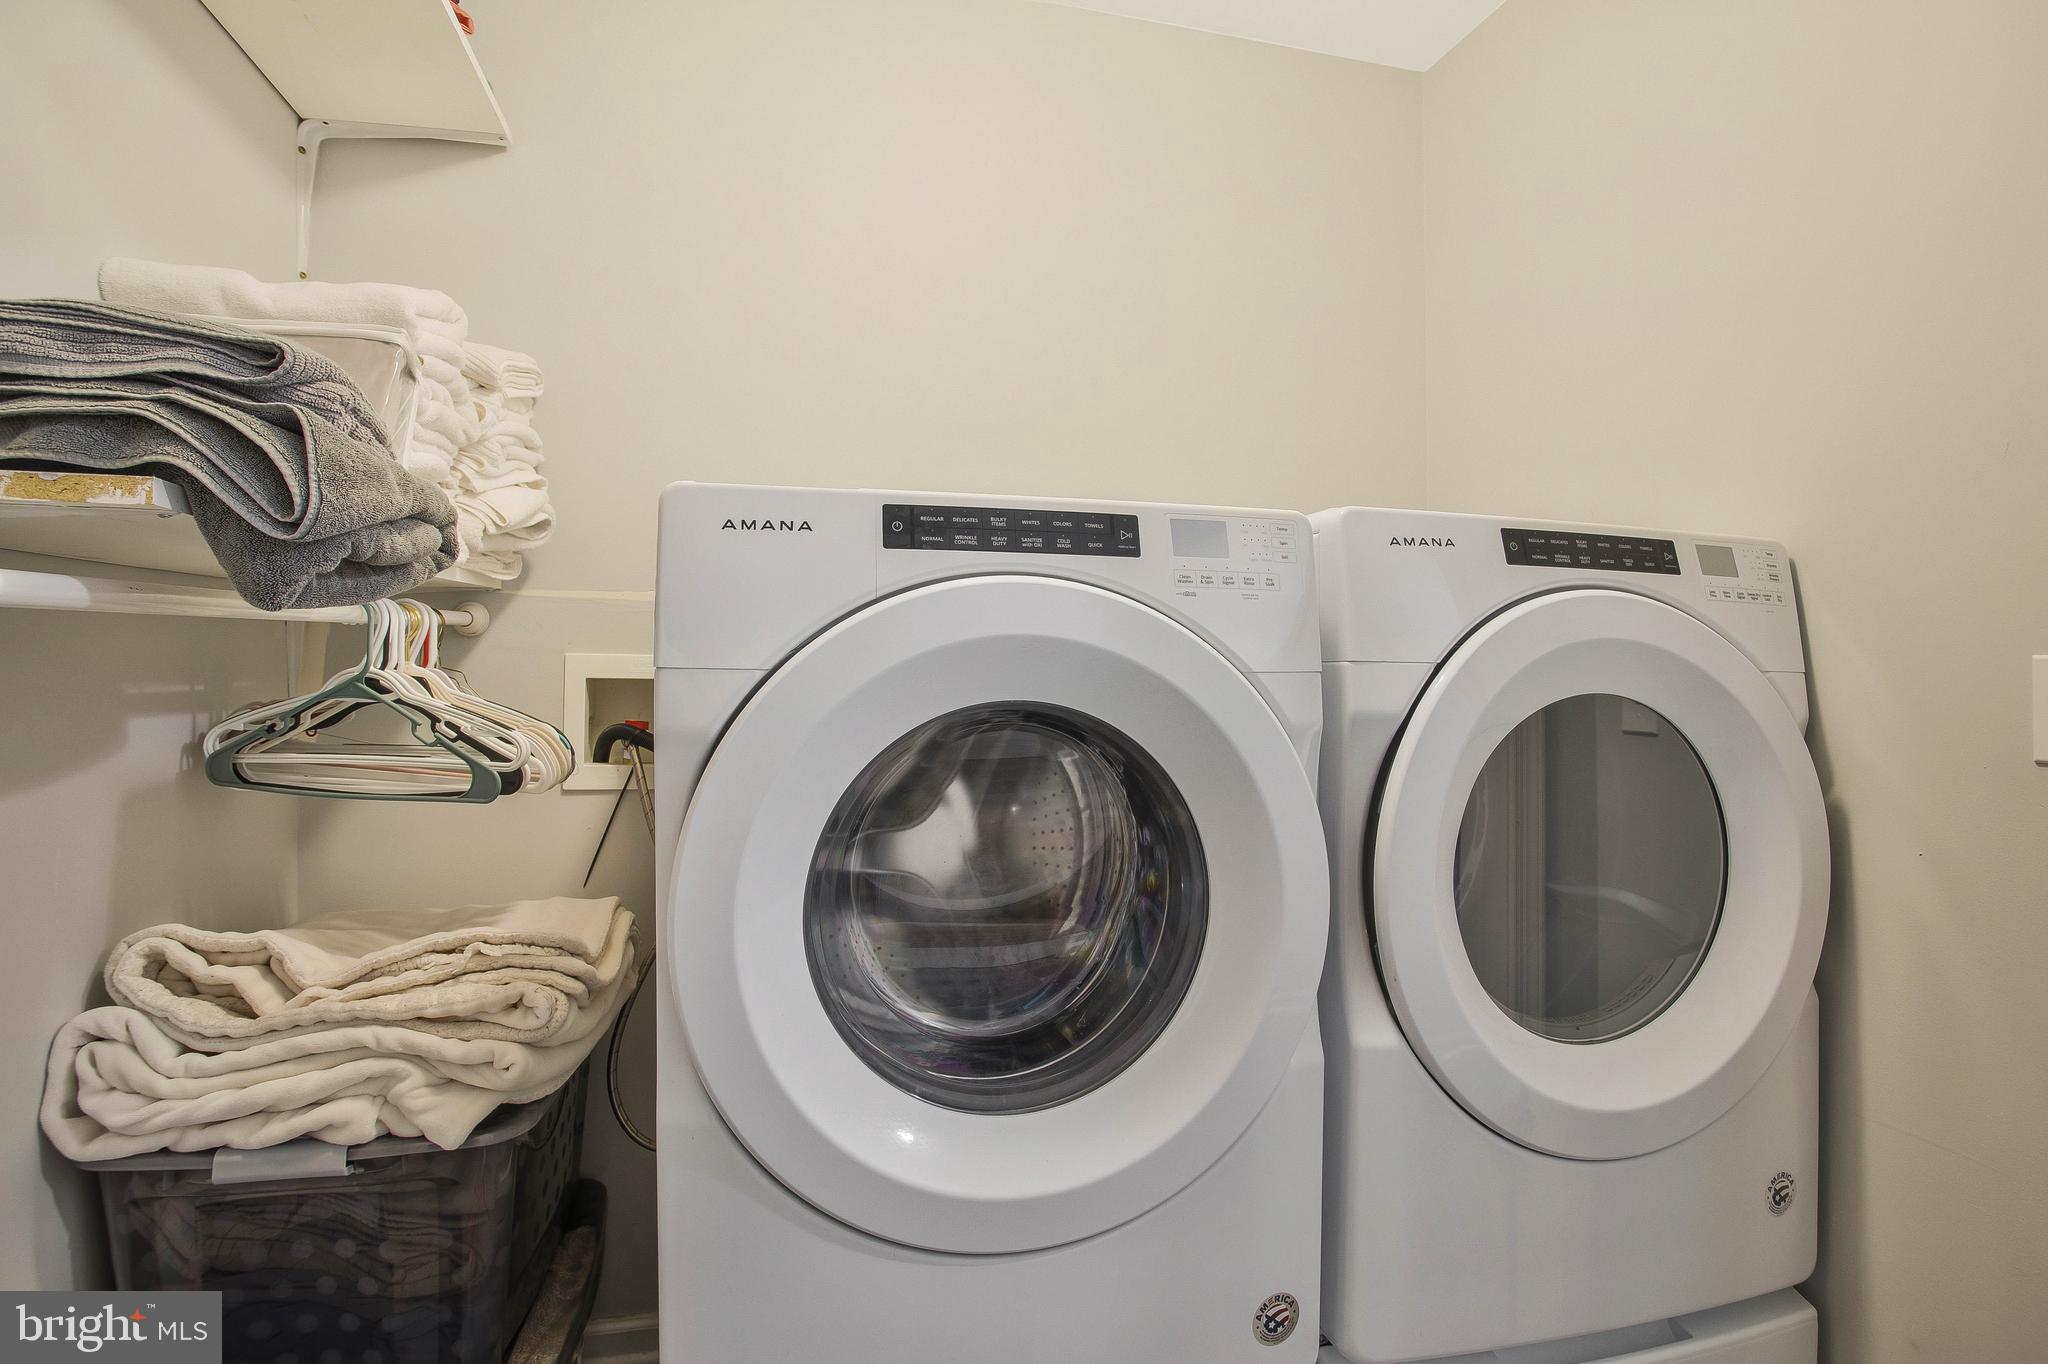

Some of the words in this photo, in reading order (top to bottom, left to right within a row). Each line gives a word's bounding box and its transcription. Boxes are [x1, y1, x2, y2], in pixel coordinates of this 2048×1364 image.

[721, 519, 813, 531] AMANA
[1389, 536, 1456, 547] AMANA
[1767, 1171, 1794, 1193] AMERICA
[1256, 1295, 1295, 1321] AMERICA
